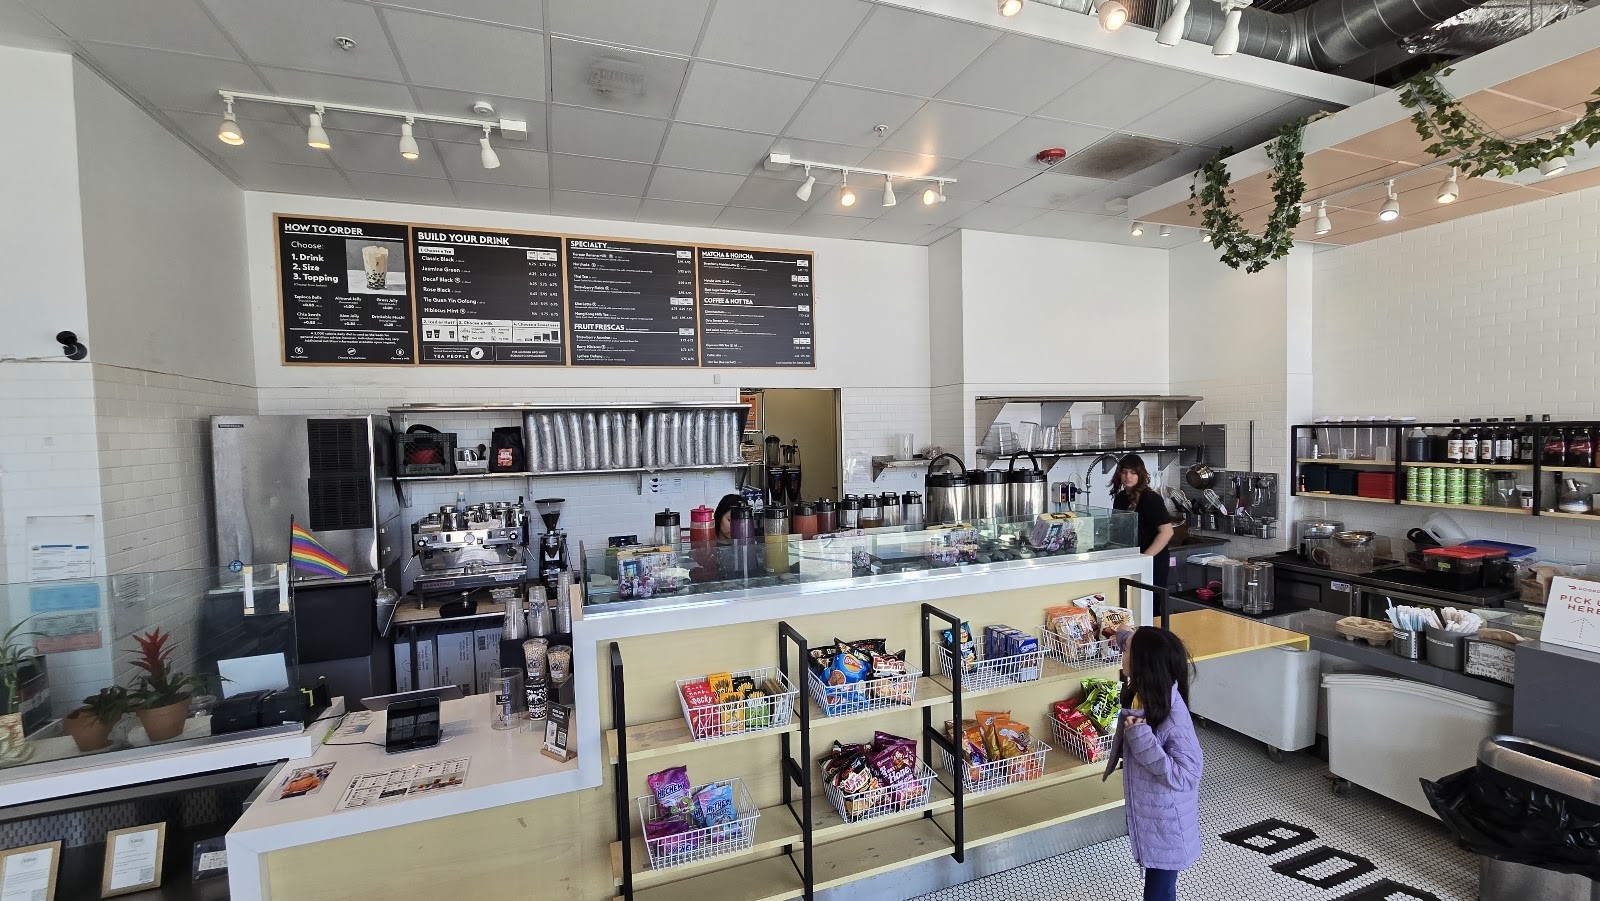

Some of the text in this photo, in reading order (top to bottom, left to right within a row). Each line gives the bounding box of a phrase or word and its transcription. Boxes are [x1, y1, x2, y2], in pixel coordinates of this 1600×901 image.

[284, 222, 364, 236] HOW TO ORDER
[418, 232, 510, 246] BUILD YOUR DRINK
[570, 240, 608, 248] SPECIALTY
[291, 240, 324, 250] Choose:
[292, 253, 324, 262] 1. Drink
[292, 263, 320, 272] 2. Size
[302, 273, 338, 284] Topping
[1560, 594, 1592, 605] PICK
[1568, 604, 1600, 614] HERE
